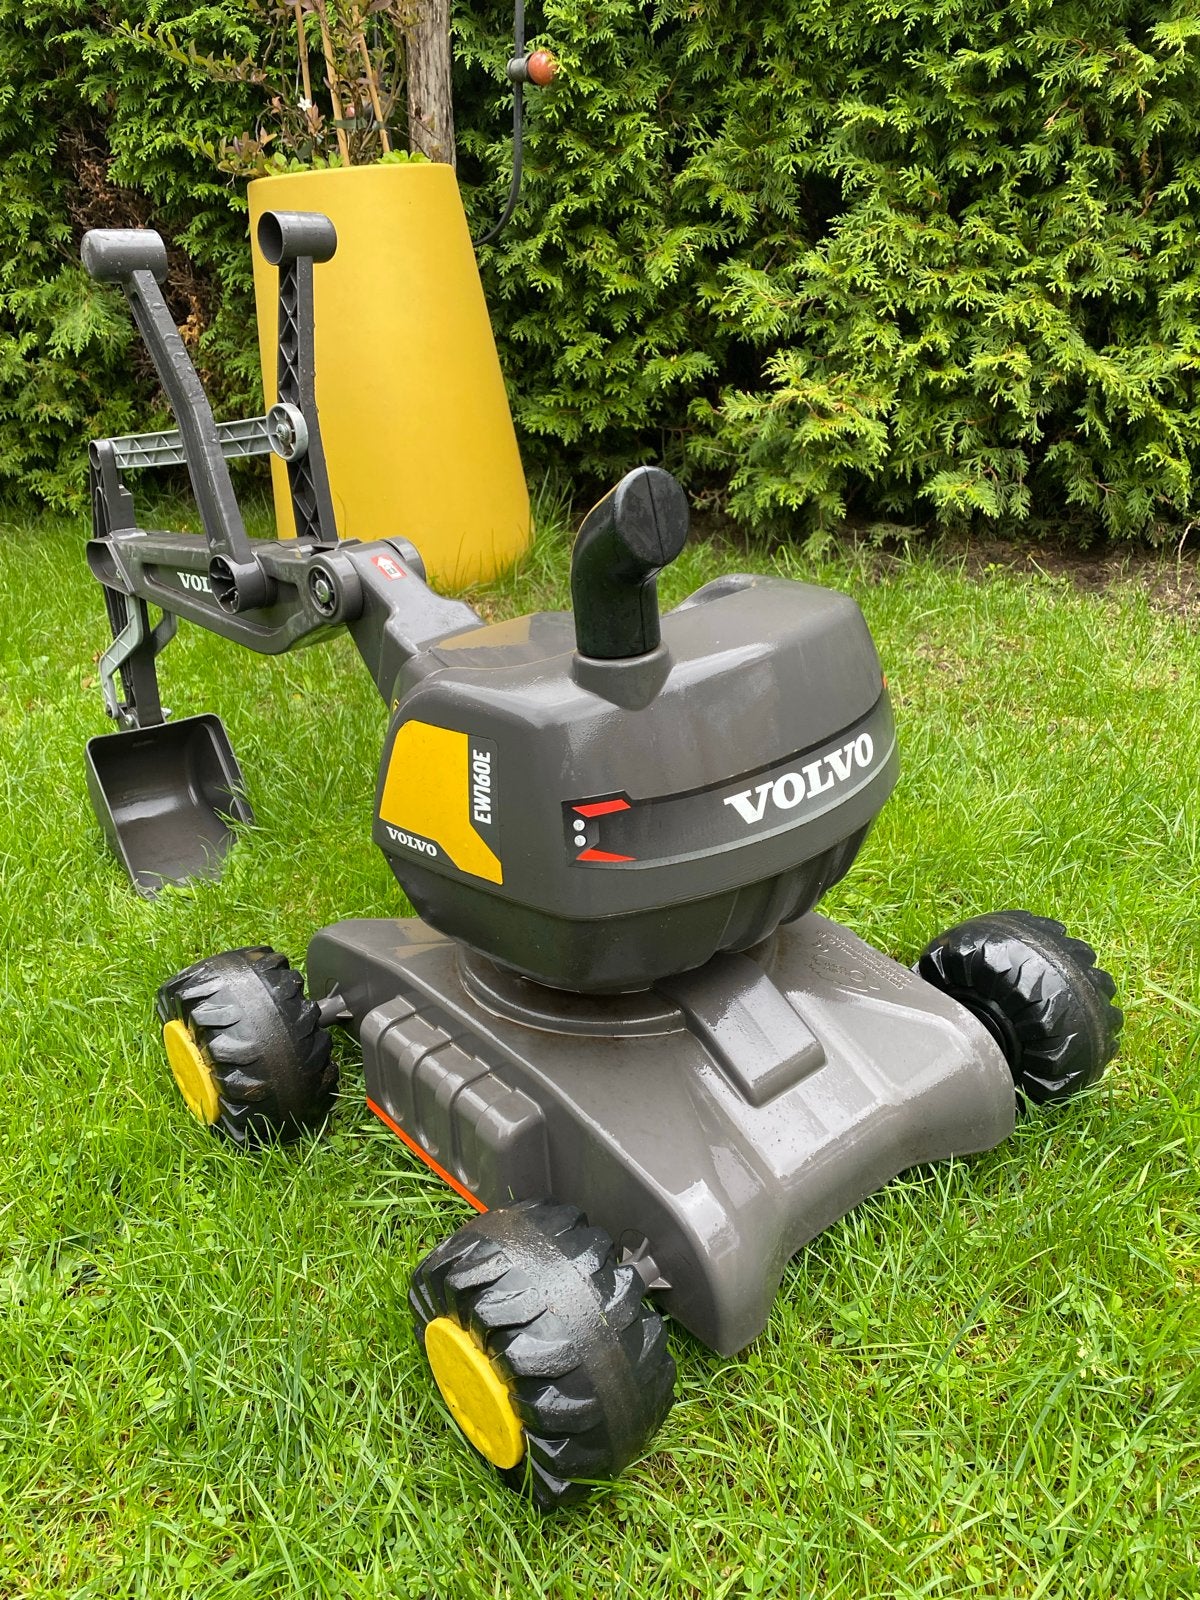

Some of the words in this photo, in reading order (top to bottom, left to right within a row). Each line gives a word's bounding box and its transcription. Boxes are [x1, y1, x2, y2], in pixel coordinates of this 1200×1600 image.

[177, 572, 213, 593] VOL
[472, 749, 492, 825] EW160E
[723, 732, 874, 825] VOLVO
[386, 826, 438, 857] VOLVO
